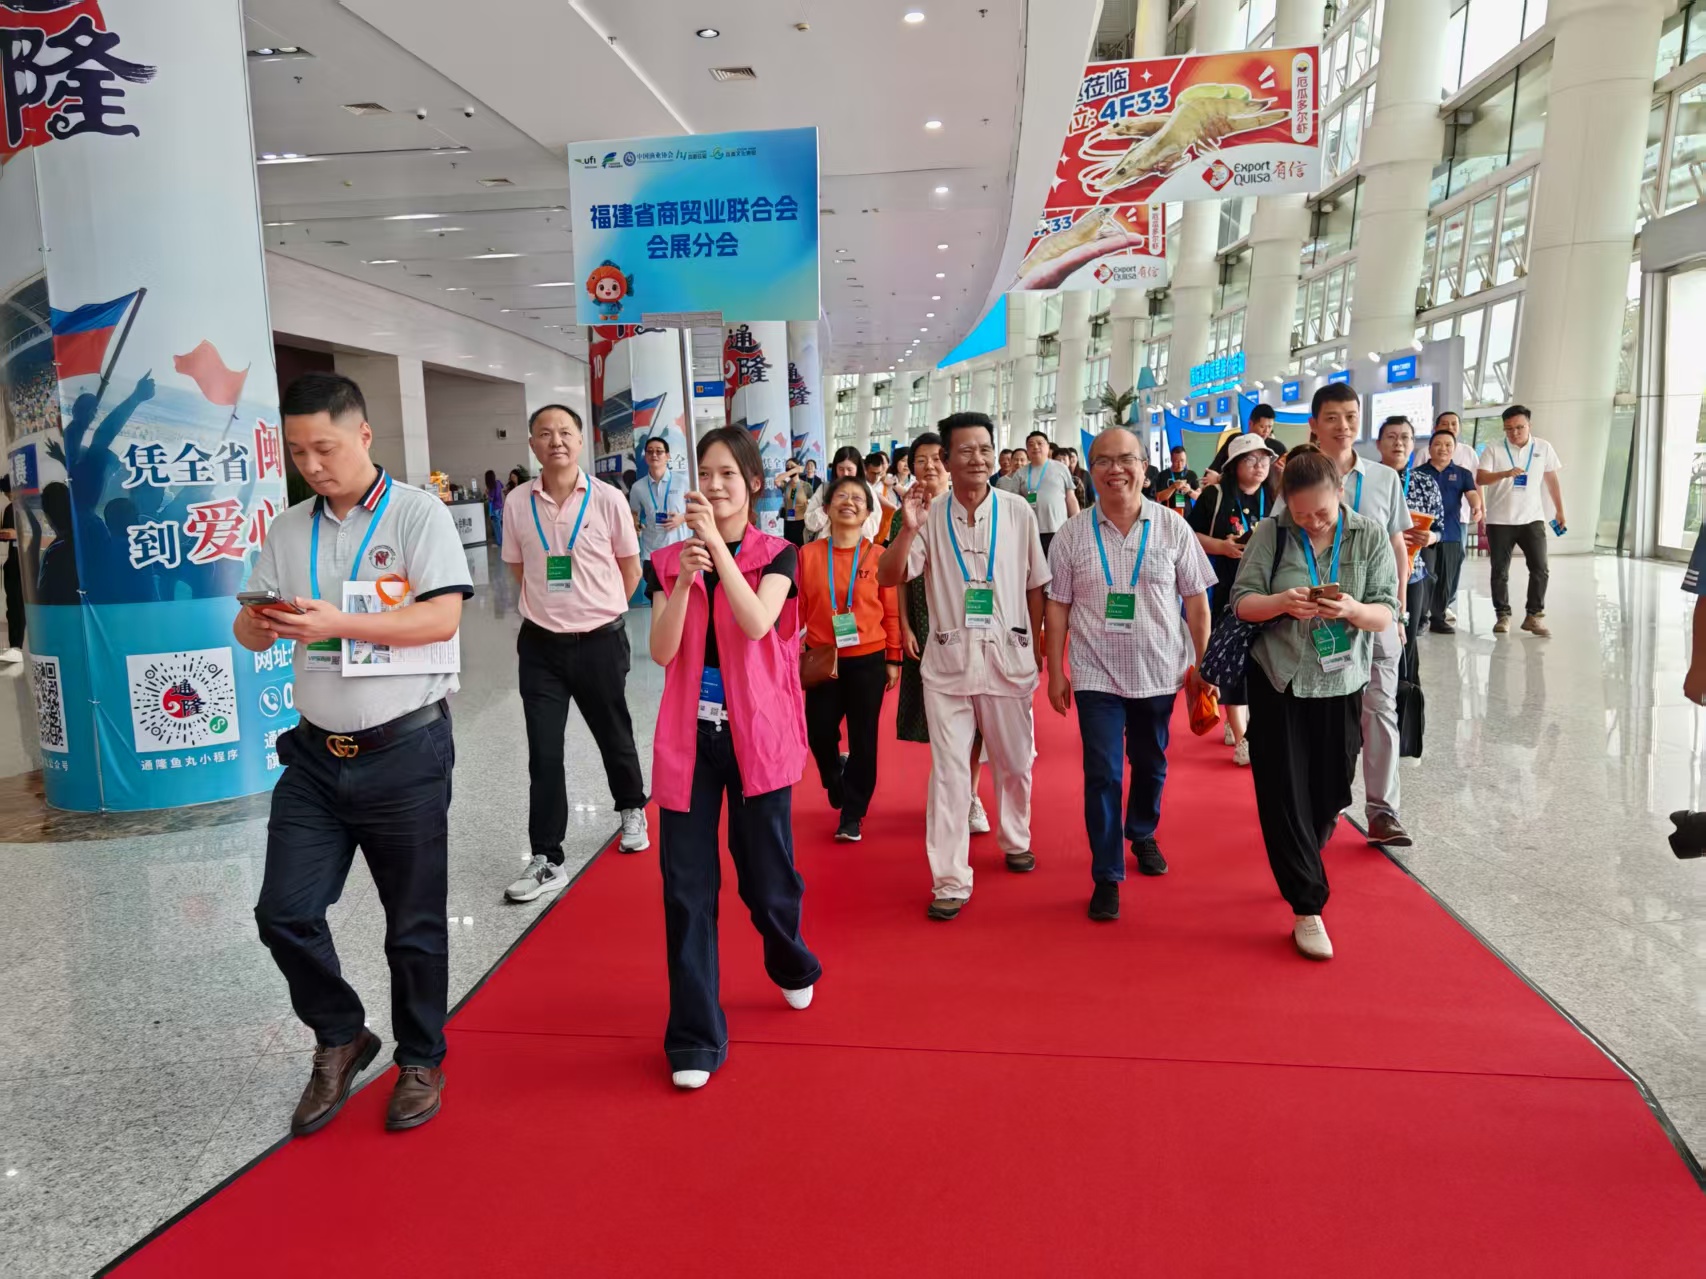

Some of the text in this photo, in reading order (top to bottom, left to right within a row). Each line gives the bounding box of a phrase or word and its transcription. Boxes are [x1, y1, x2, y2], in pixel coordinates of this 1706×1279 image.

[1077, 70, 1127, 105] 莅临
[1100, 86, 1169, 121] 4F33
[1296, 76, 1308, 133] 厄瓜多尔虾
[1234, 161, 1271, 174] Export
[1273, 161, 1308, 180] 有信
[590, 195, 799, 229] 福建省商贸业联合会
[646, 232, 739, 259] 会展分会
[141, 749, 238, 771] 通隆鱼丸小程序
